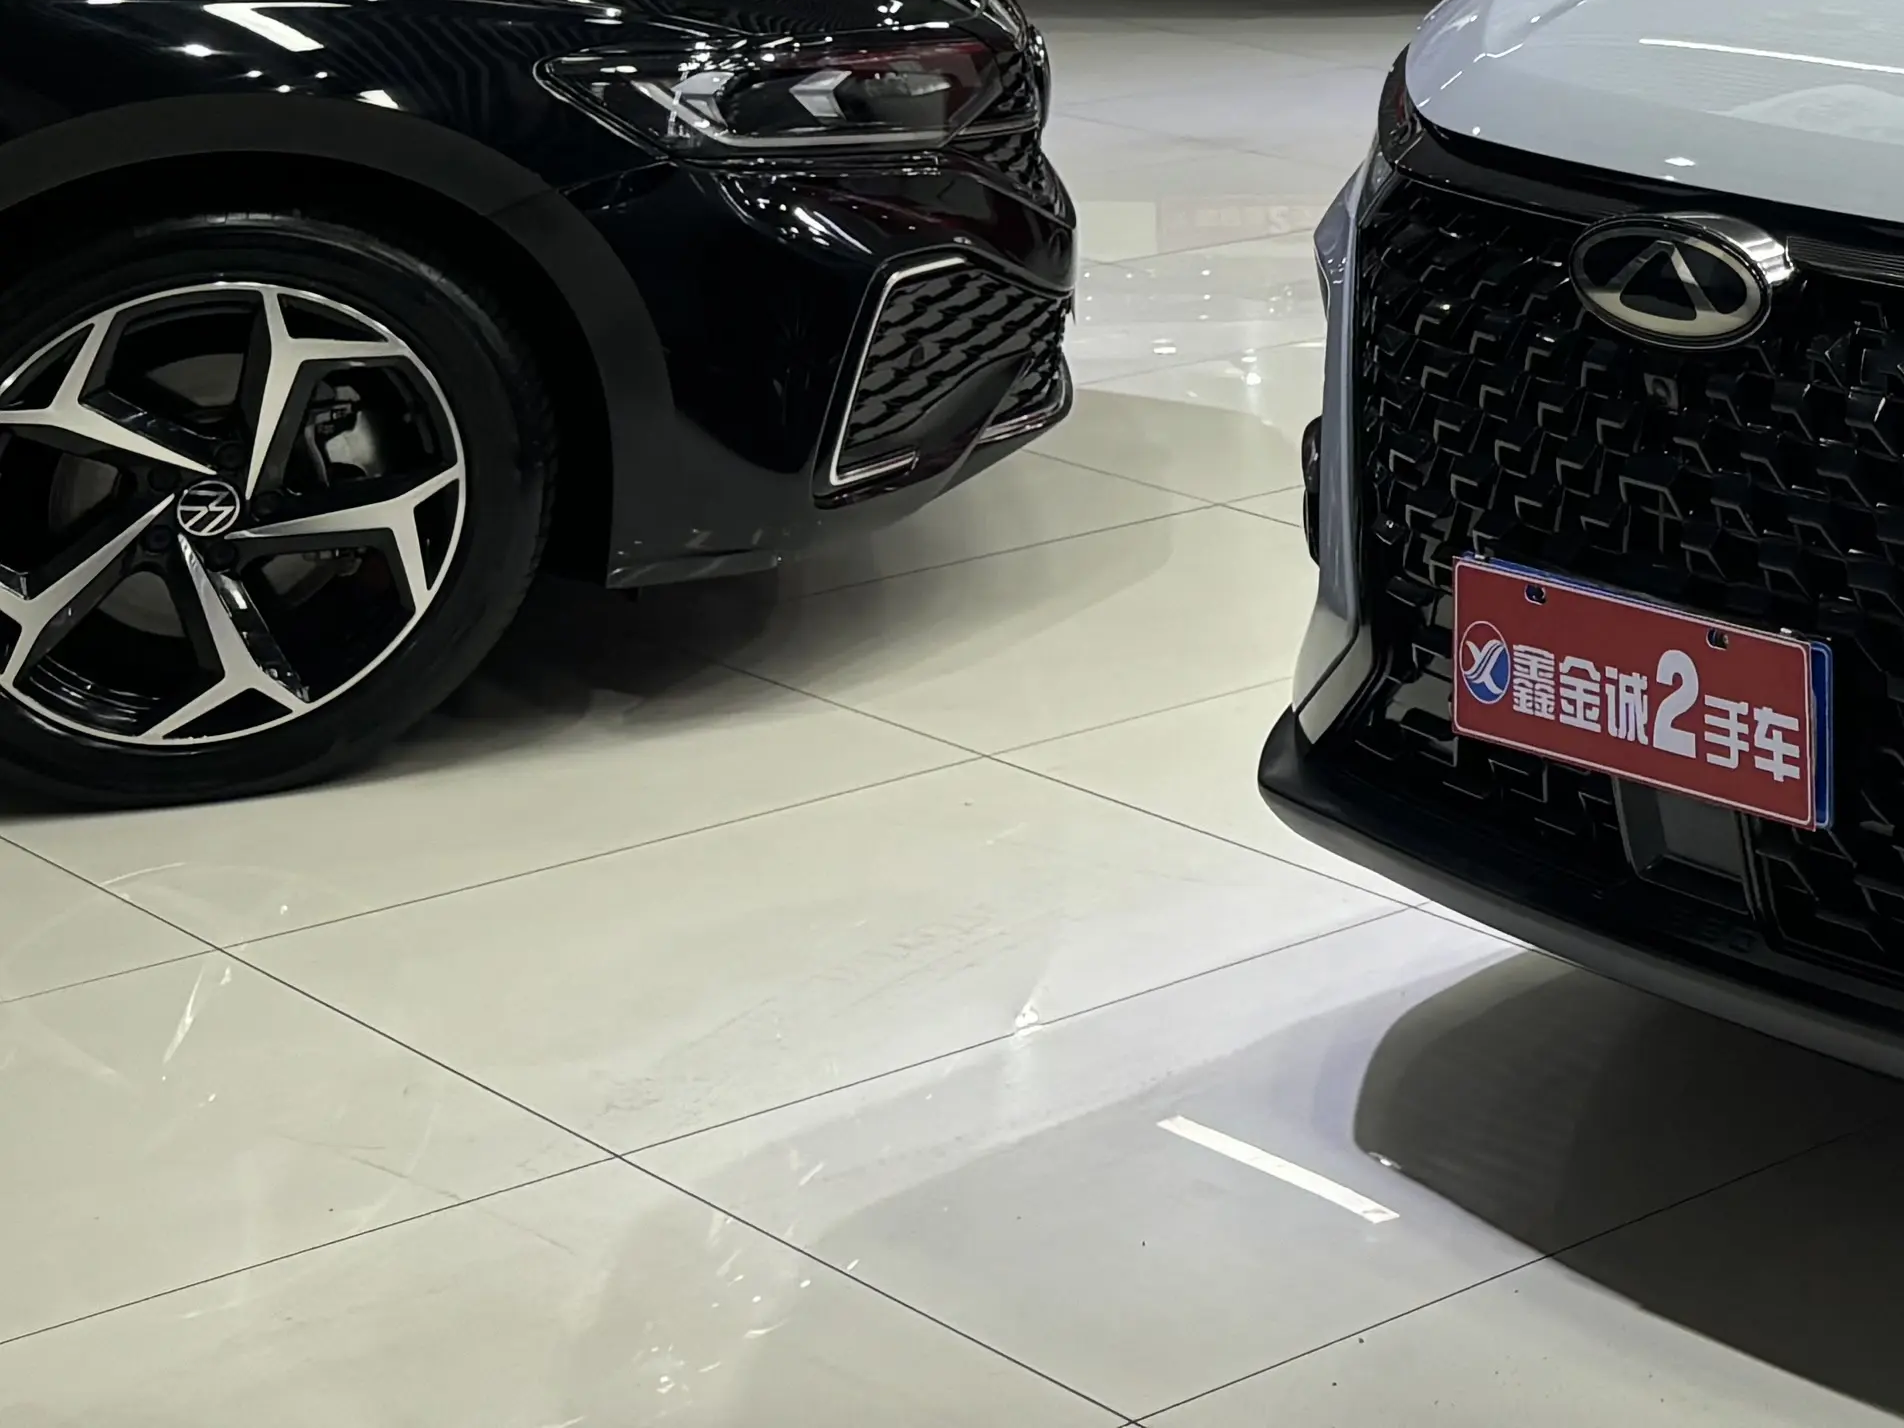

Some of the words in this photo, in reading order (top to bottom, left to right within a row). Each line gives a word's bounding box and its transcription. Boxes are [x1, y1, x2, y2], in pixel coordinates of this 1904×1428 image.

[1512, 643, 1801, 783] 鑫金诚2手车
